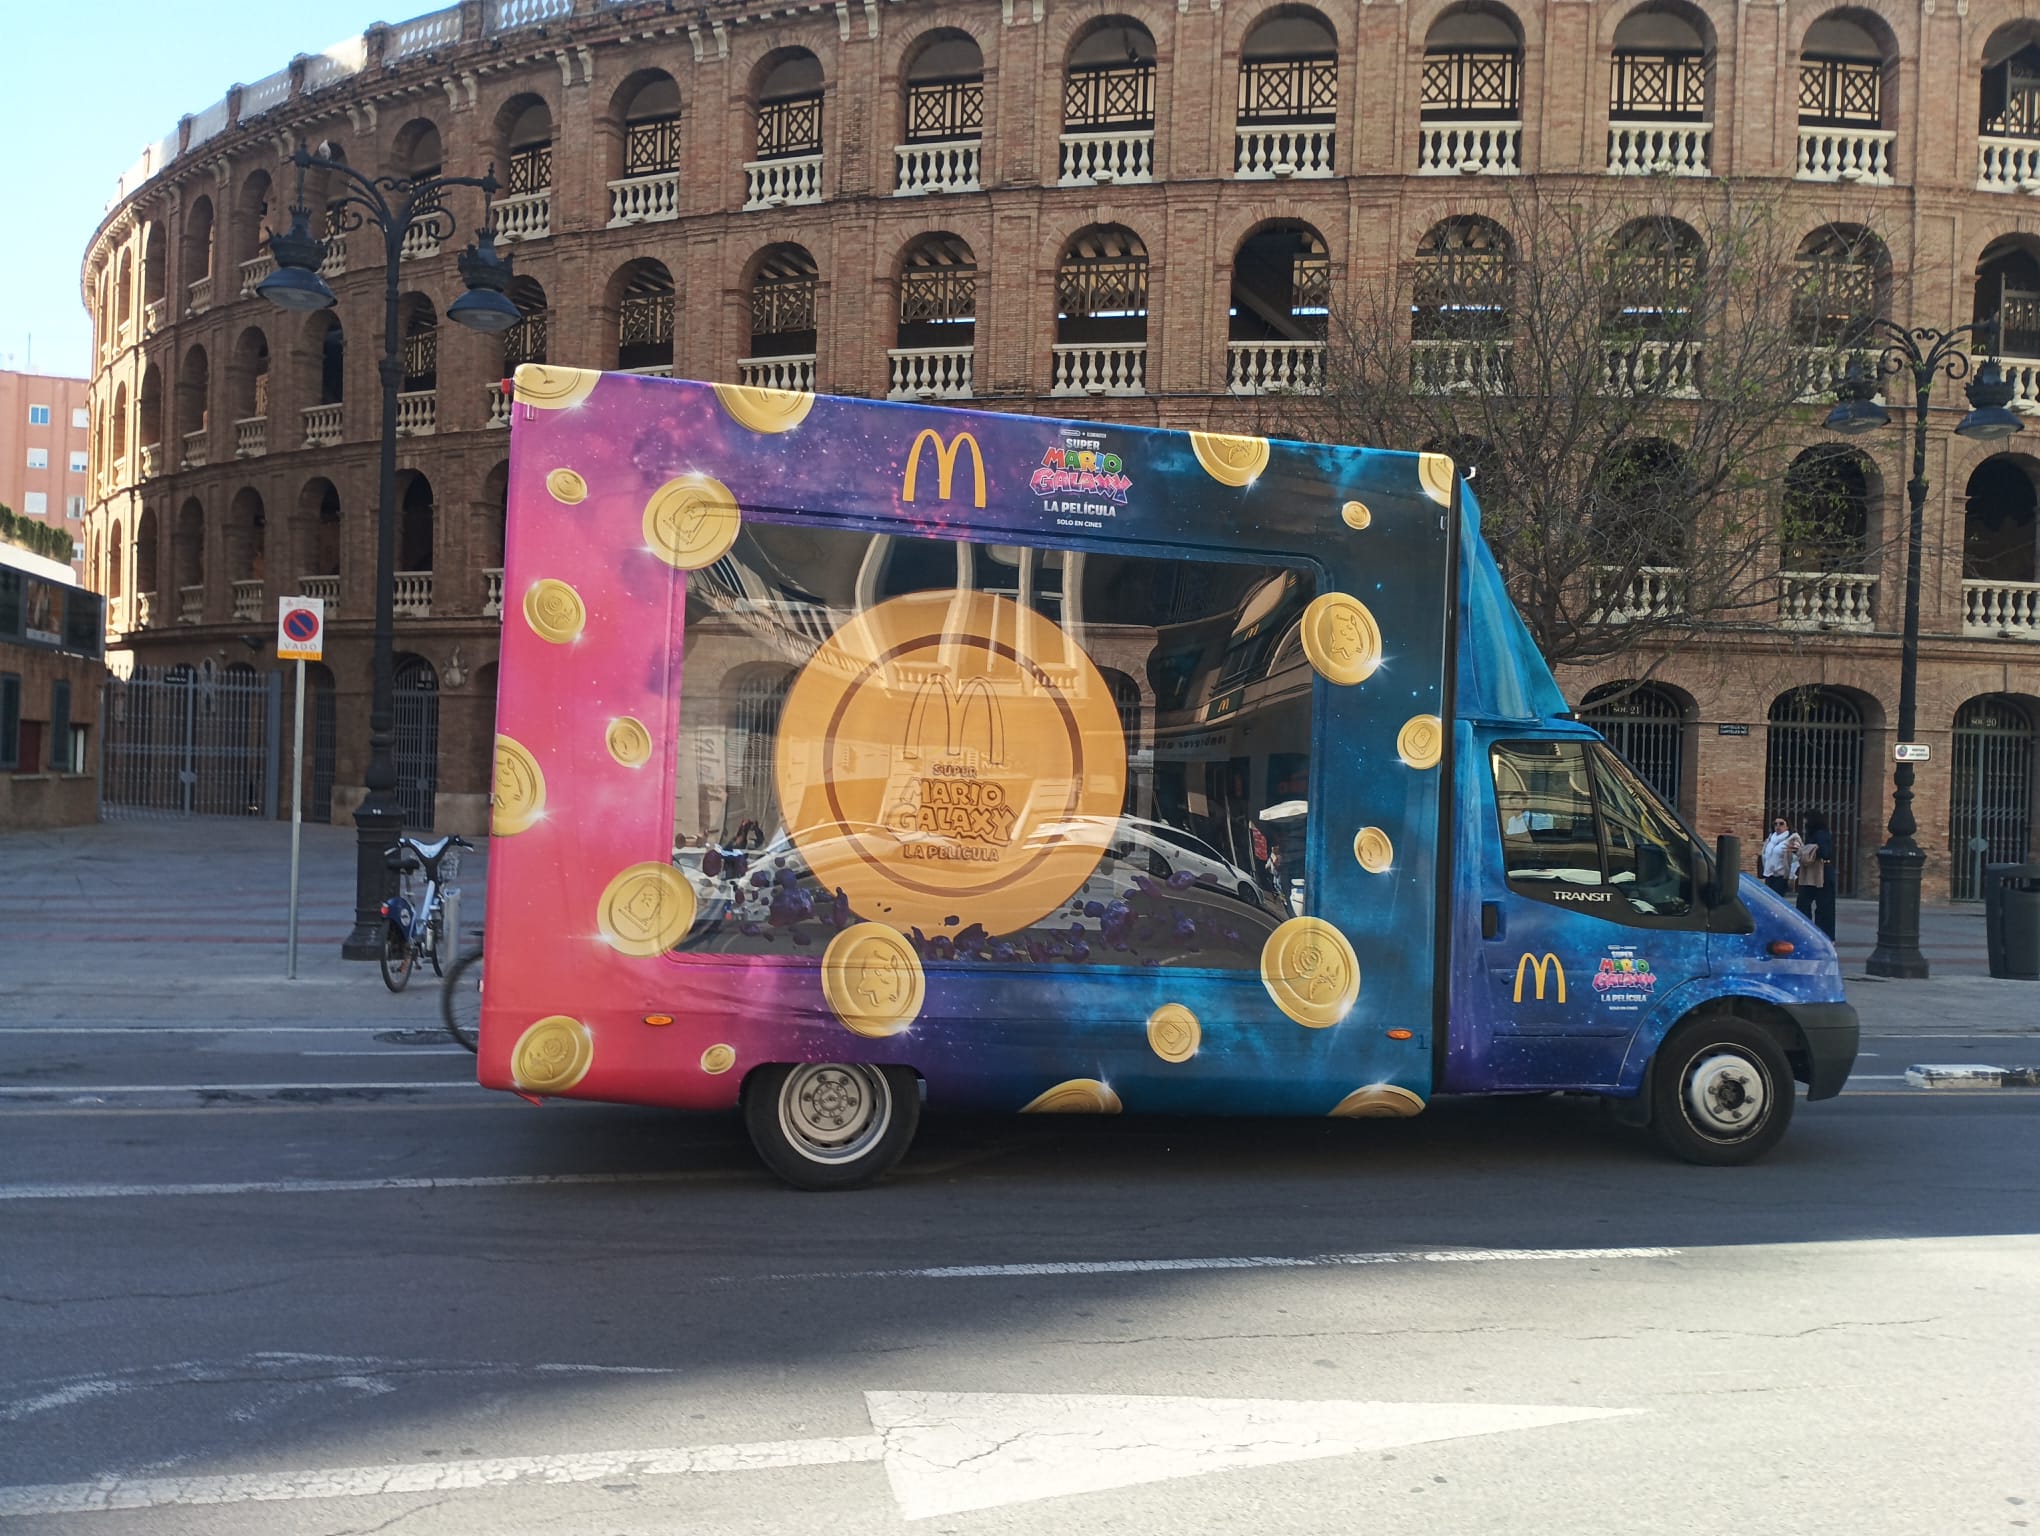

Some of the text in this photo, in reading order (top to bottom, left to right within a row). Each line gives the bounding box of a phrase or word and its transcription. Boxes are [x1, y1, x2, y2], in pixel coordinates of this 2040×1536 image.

[1066, 438, 1100, 450] SUPER
[903, 428, 986, 508] M
[1041, 446, 1122, 475] MARIO
[1029, 467, 1133, 504] GALAXY
[1043, 500, 1117, 518] LA PELÍCULA
[1056, 518, 1074, 526] SOLO
[283, 642, 317, 651] VADO
[932, 763, 978, 779] SUPER
[900, 776, 1006, 807] MARIO
[887, 803, 1019, 848] GALAXY
[903, 844, 1000, 862] LA PELÍCULA
[1553, 890, 1614, 902] TRANSIT
[1513, 952, 1567, 1004] M
[1601, 994, 1611, 1002] LA
